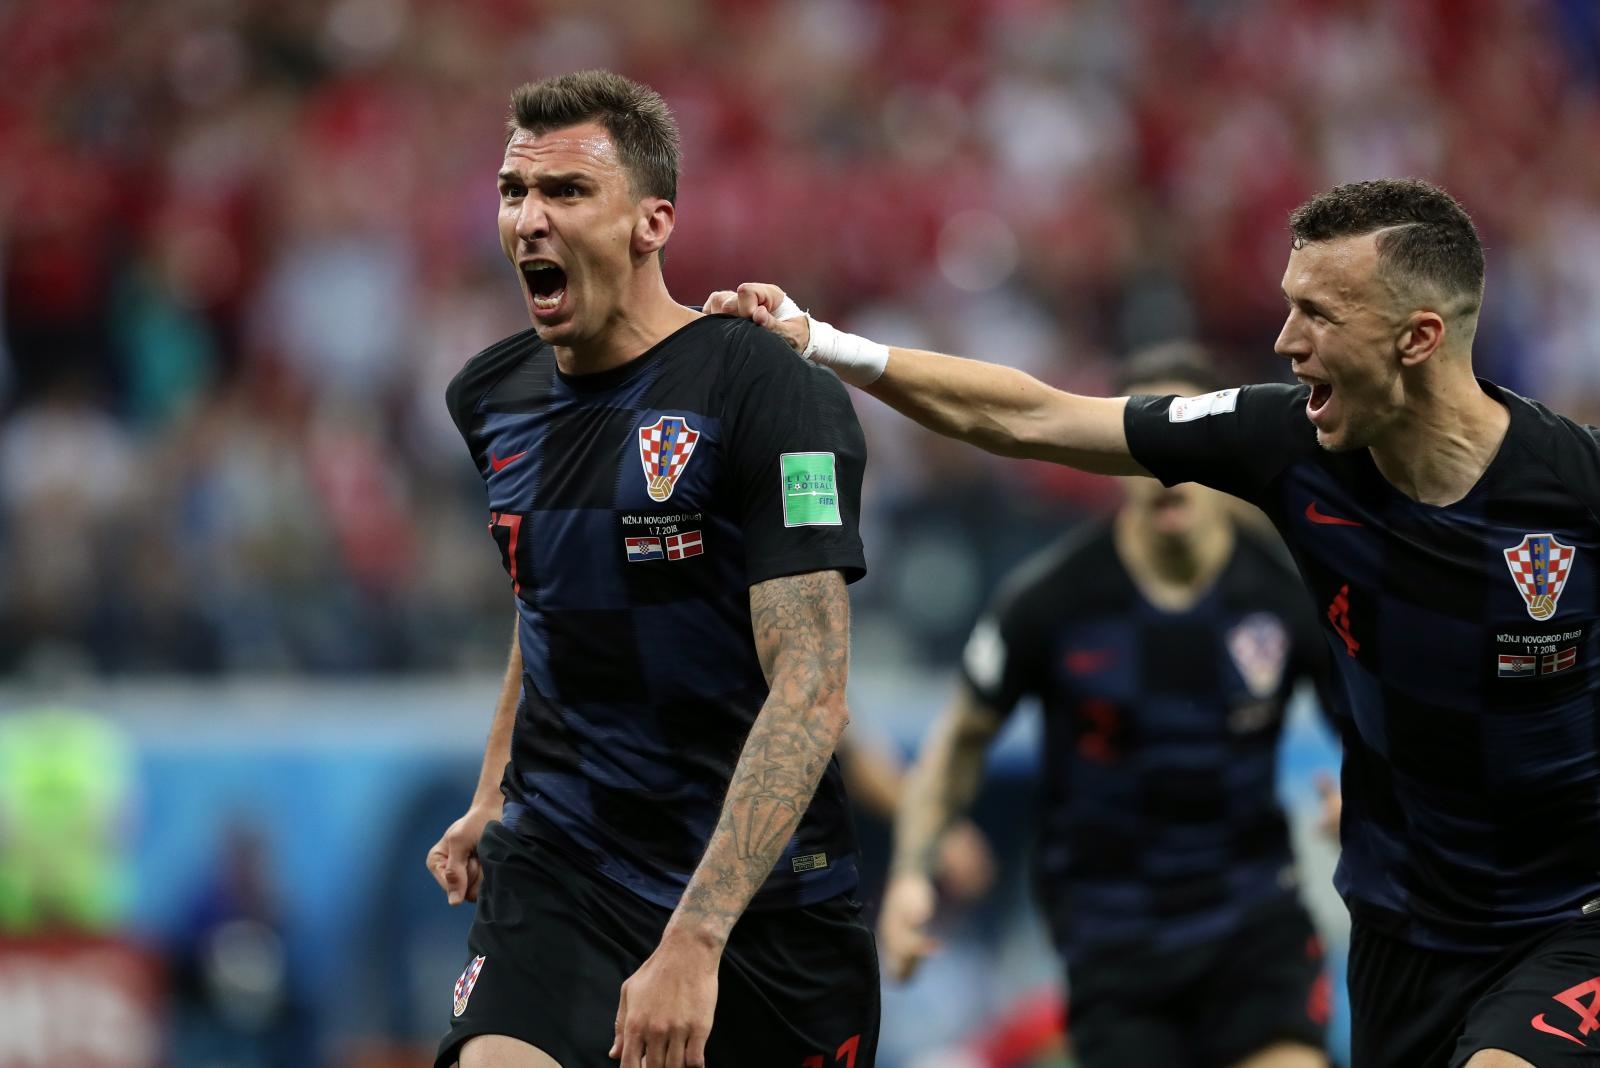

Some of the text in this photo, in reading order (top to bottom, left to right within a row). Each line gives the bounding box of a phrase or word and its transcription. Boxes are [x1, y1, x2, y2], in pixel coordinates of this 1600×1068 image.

[661, 425, 675, 467] HNS
[819, 497, 834, 505] FIFA
[643, 514, 681, 525] NOVGOROD
[1534, 543, 1546, 586] HNS
[1521, 634, 1562, 644] NOVGOROD
